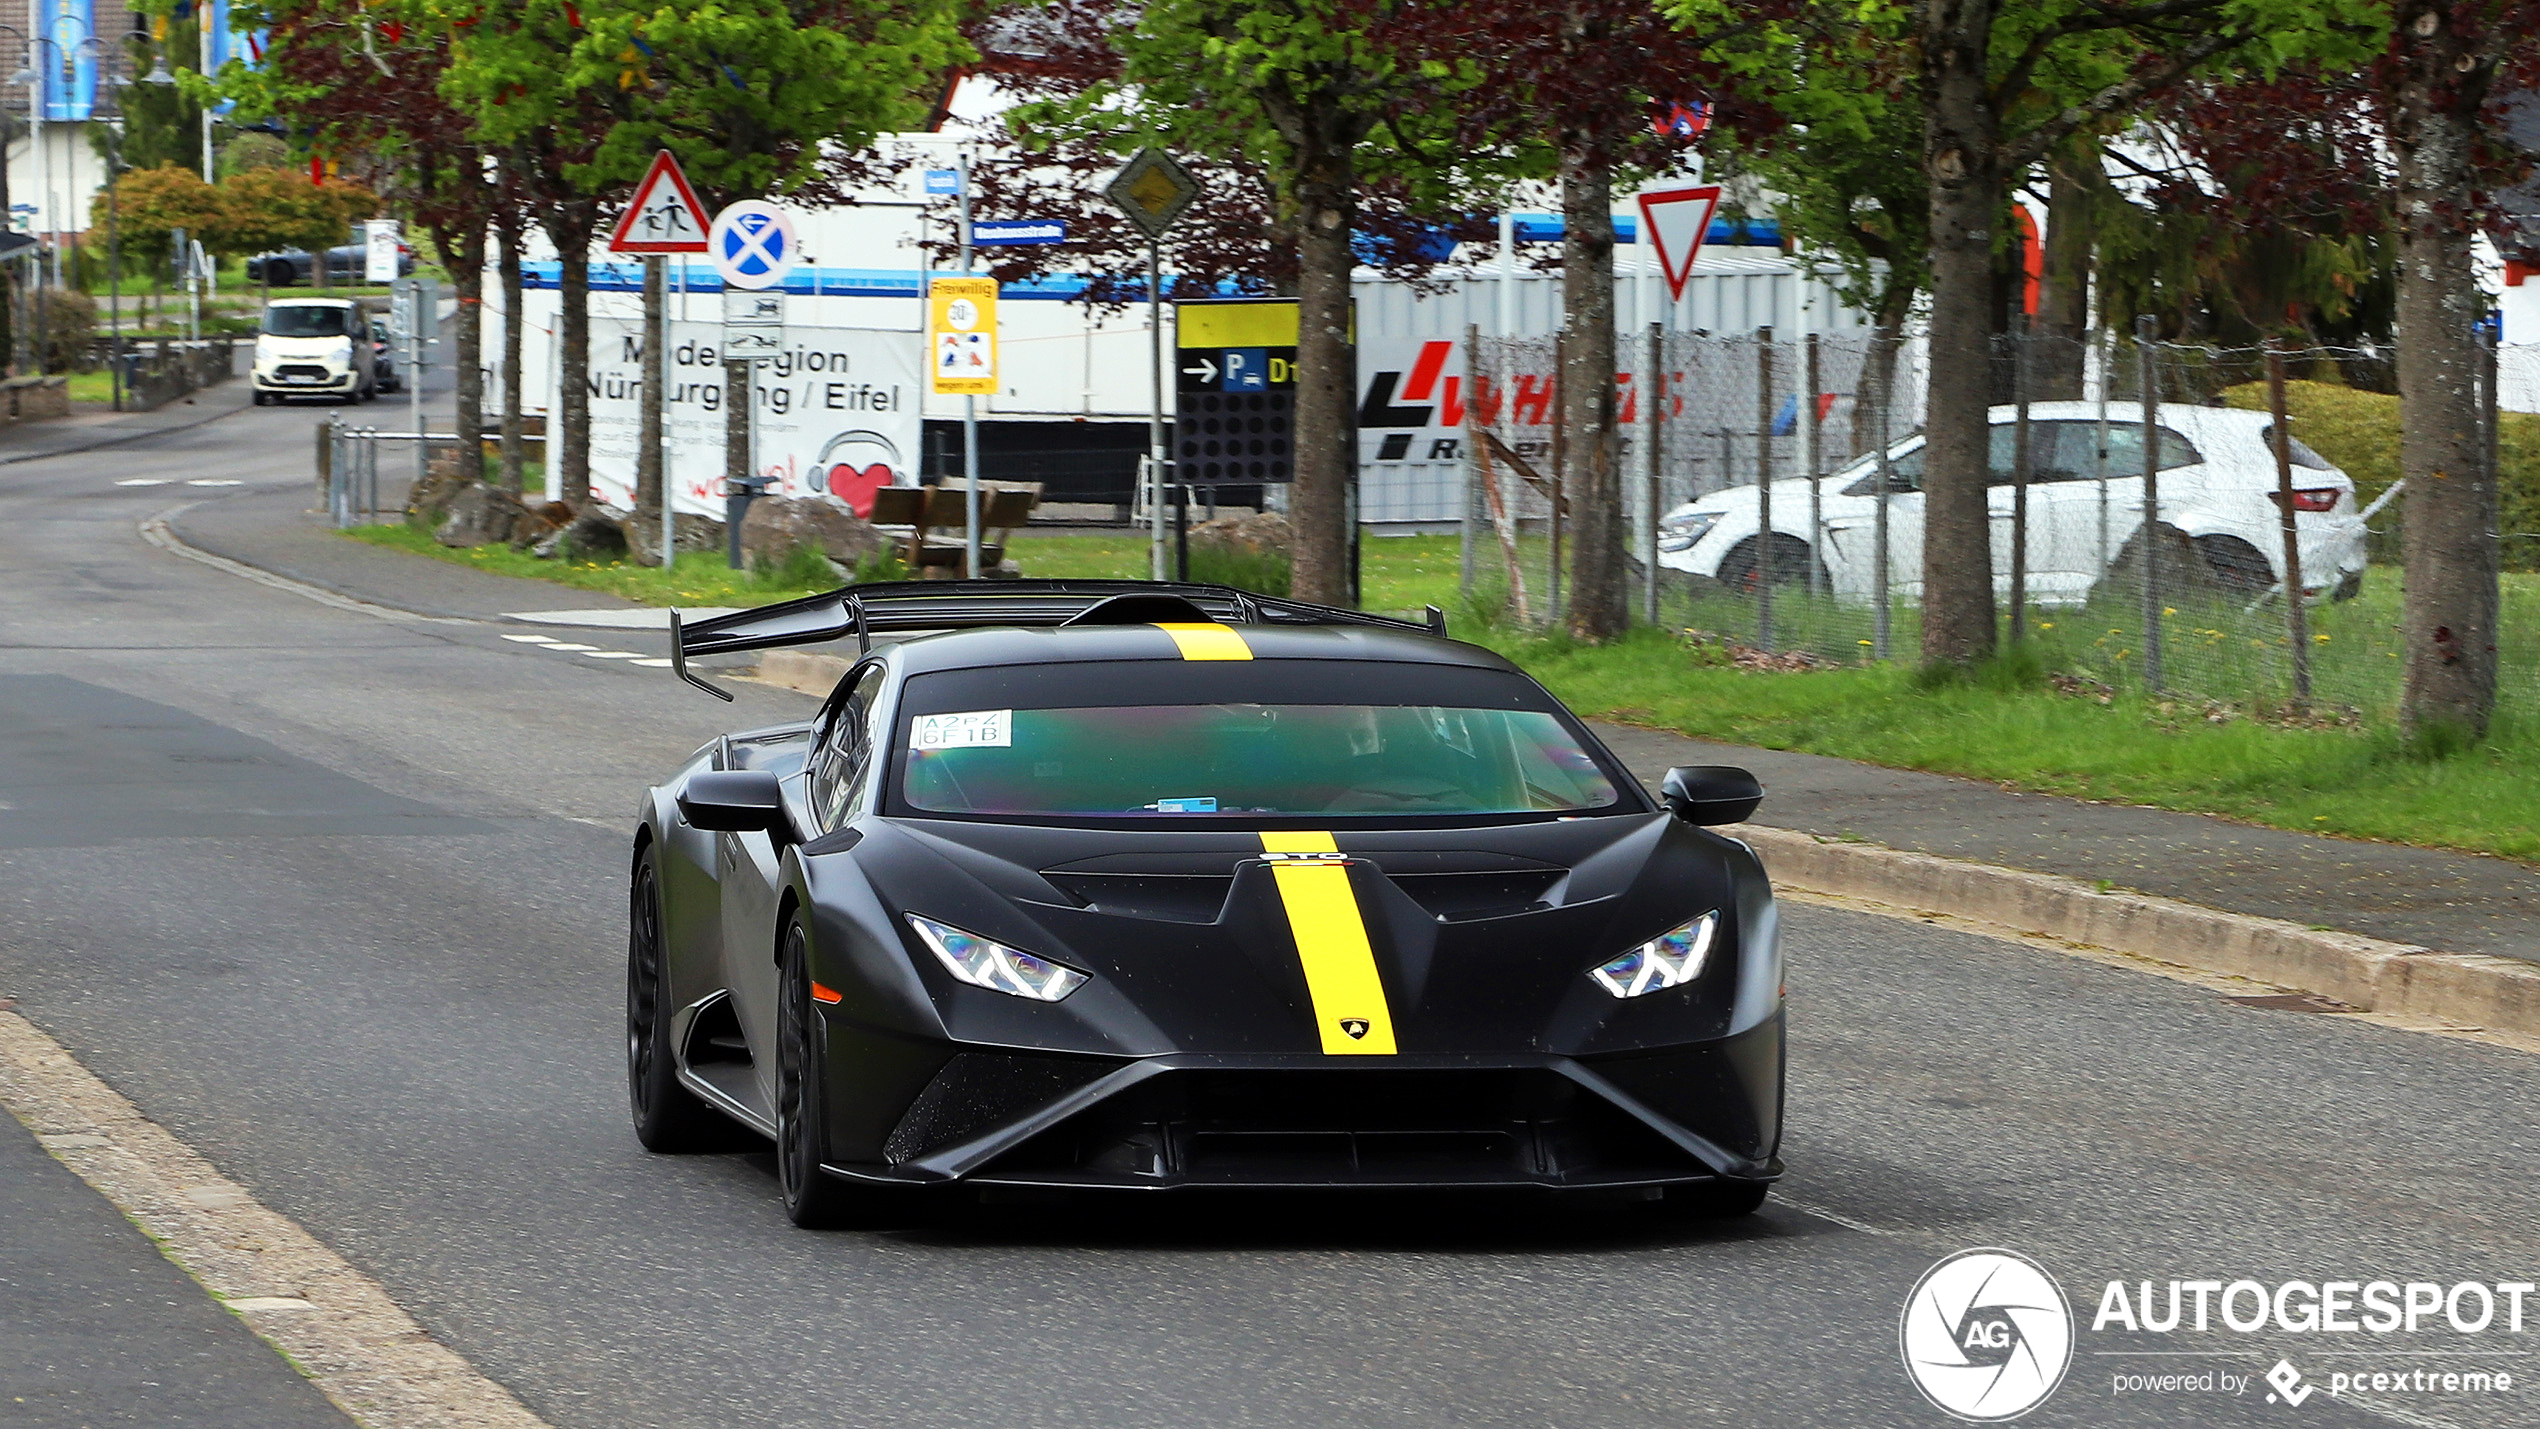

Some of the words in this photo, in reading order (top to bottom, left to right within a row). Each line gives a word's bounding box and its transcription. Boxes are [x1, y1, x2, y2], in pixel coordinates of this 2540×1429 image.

[932, 282, 992, 298] Freiwillig
[825, 382, 900, 412] Eifel
[923, 727, 998, 745] 6F1B
[1259, 852, 1349, 861] STO
